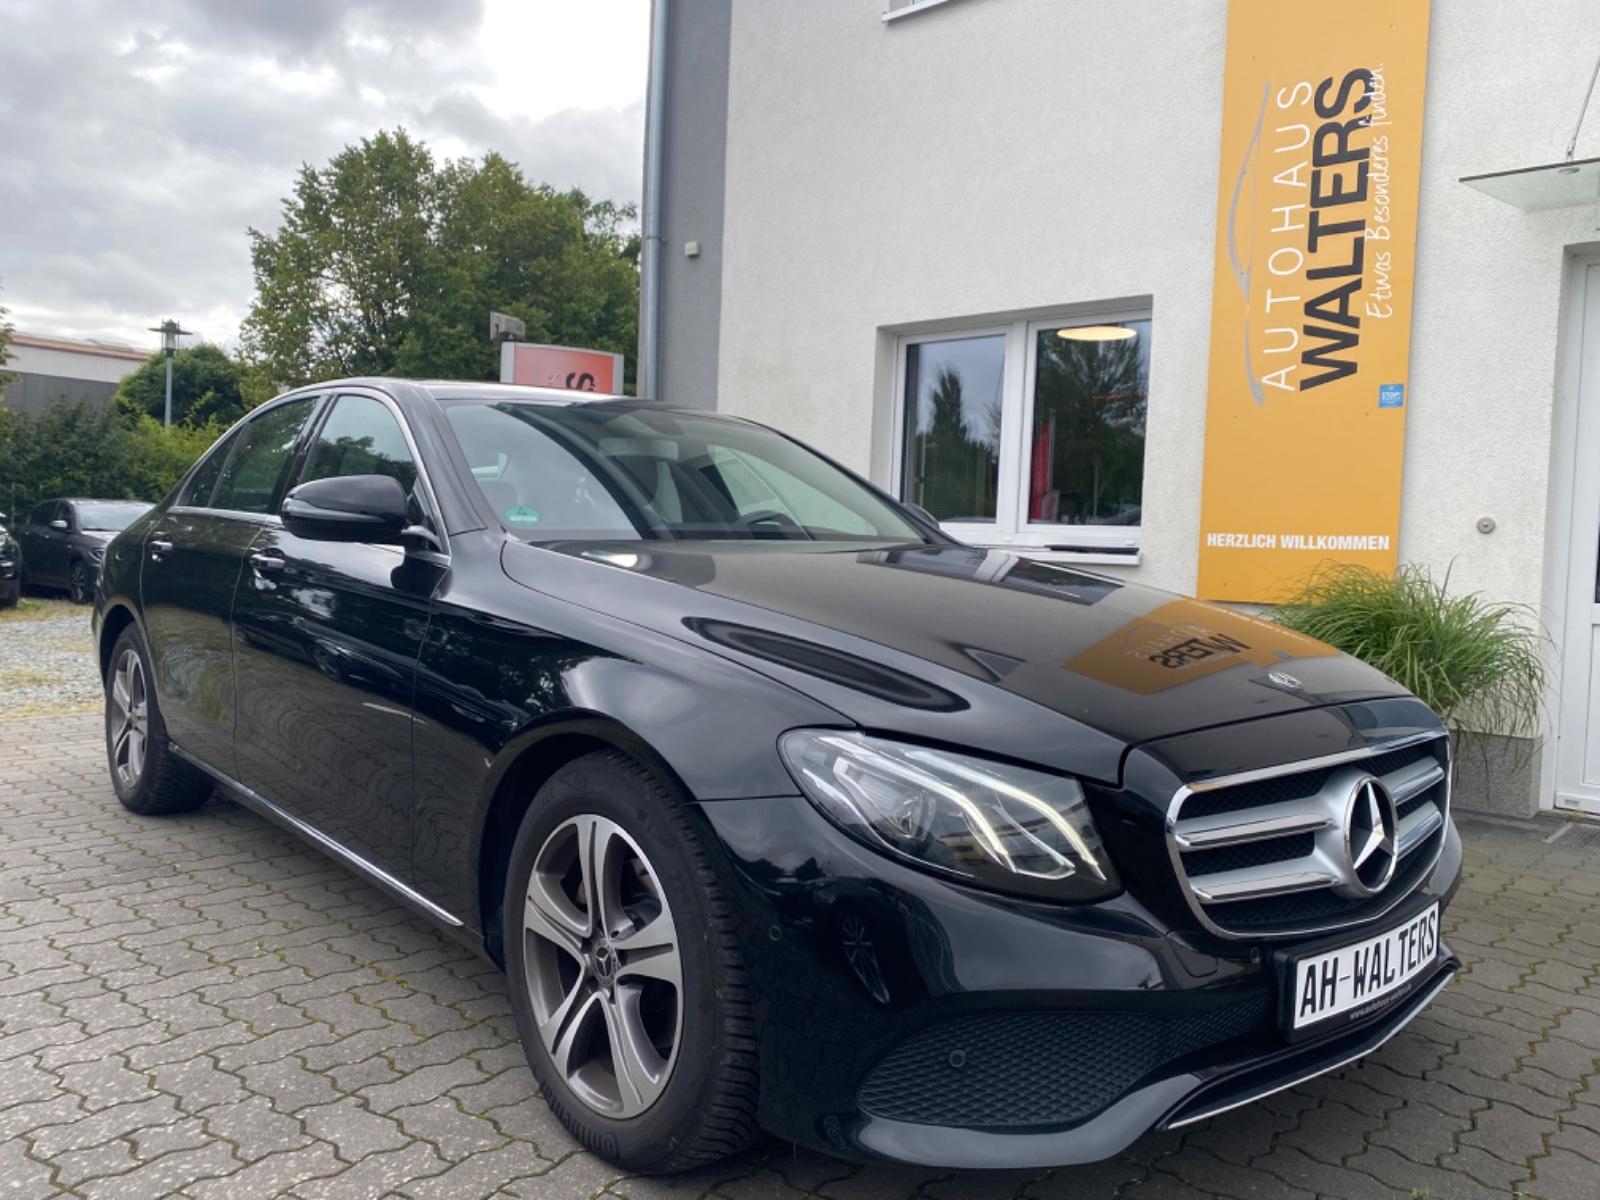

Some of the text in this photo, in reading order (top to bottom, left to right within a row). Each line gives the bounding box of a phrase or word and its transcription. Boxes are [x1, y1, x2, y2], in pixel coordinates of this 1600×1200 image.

[1262, 81, 1313, 392] AUTOHAUS
[1299, 67, 1375, 392] WALTERS
[1364, 135, 1391, 242] Besonderes
[1366, 251, 1393, 319] Etwas
[1207, 533, 1390, 550] HERZLICH WILLKOMMEN
[1300, 909, 1436, 1018] AH-WALTERS
